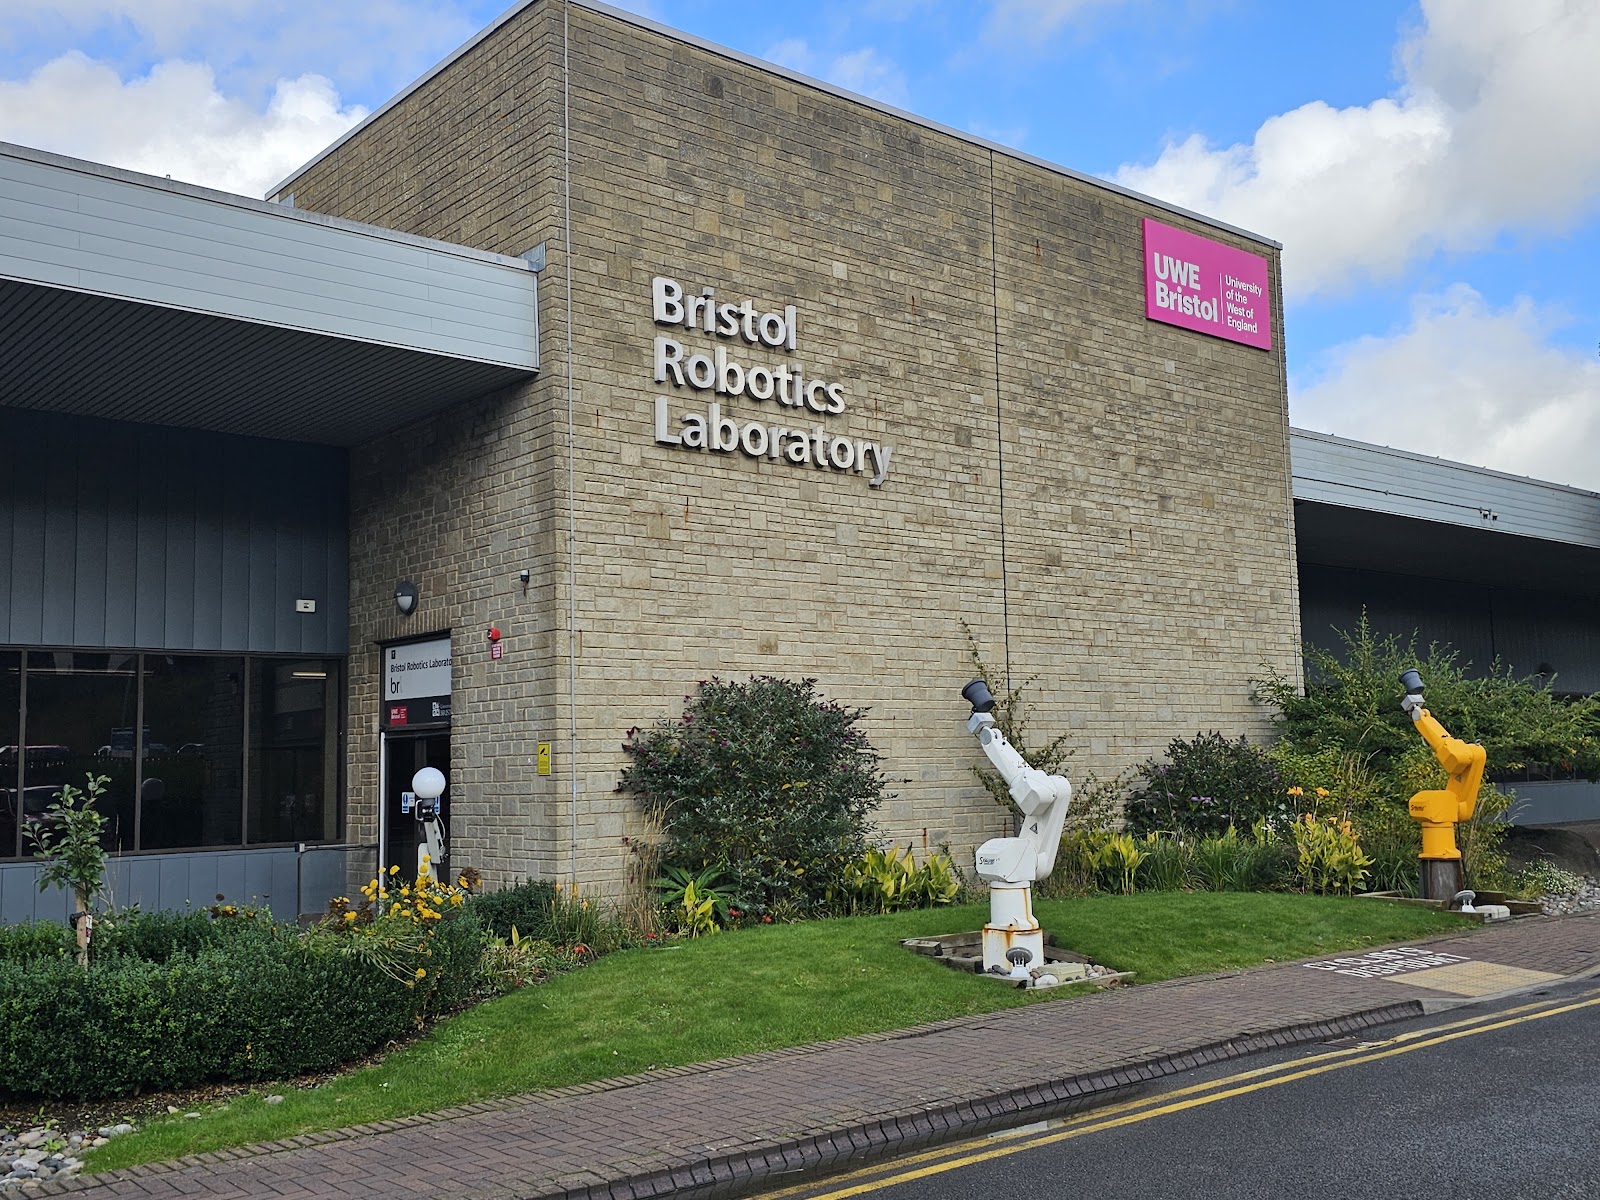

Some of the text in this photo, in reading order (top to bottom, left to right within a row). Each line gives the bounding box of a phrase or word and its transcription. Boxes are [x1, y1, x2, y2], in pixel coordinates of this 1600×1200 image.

[1154, 252, 1201, 291] UWE
[1225, 274, 1262, 297] University
[1155, 280, 1218, 323] Bristol
[1226, 289, 1248, 304] of the
[1226, 301, 1254, 319] West of
[653, 276, 797, 351] Bristol
[1227, 316, 1258, 333] England
[653, 336, 846, 415] Robotics
[654, 395, 893, 487] Laboratory
[391, 662, 406, 673] Bristol
[407, 660, 428, 671] Robotics
